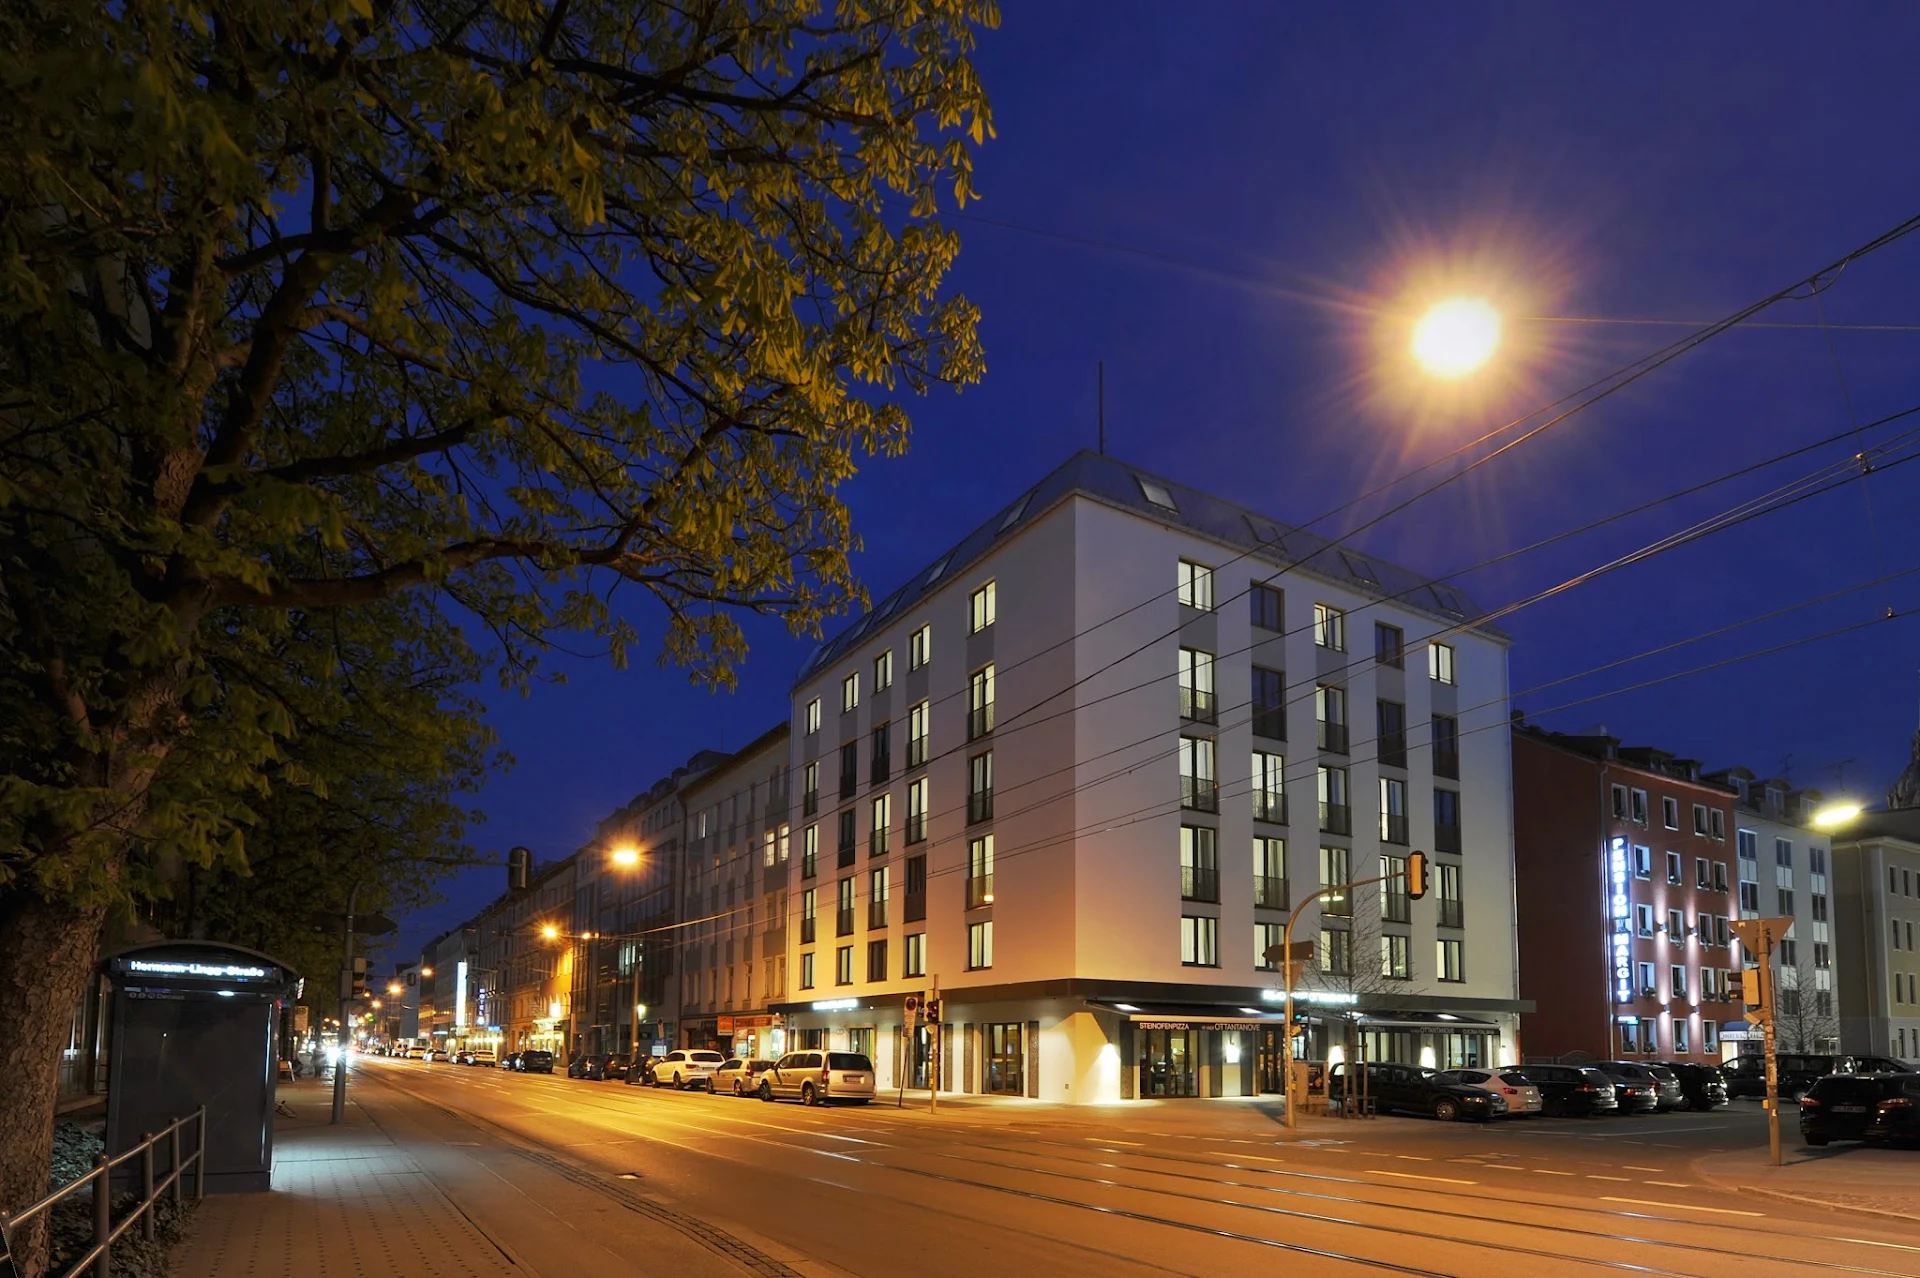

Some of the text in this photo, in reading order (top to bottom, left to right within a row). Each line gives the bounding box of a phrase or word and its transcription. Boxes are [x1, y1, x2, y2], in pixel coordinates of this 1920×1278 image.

[1612, 837, 1627, 917] PENSION
[1614, 933, 1630, 1002] MARGIT
[1139, 1022, 1190, 1031] STEINOFENPIZZA
[1214, 1023, 1261, 1032] OTTANTANOVE
